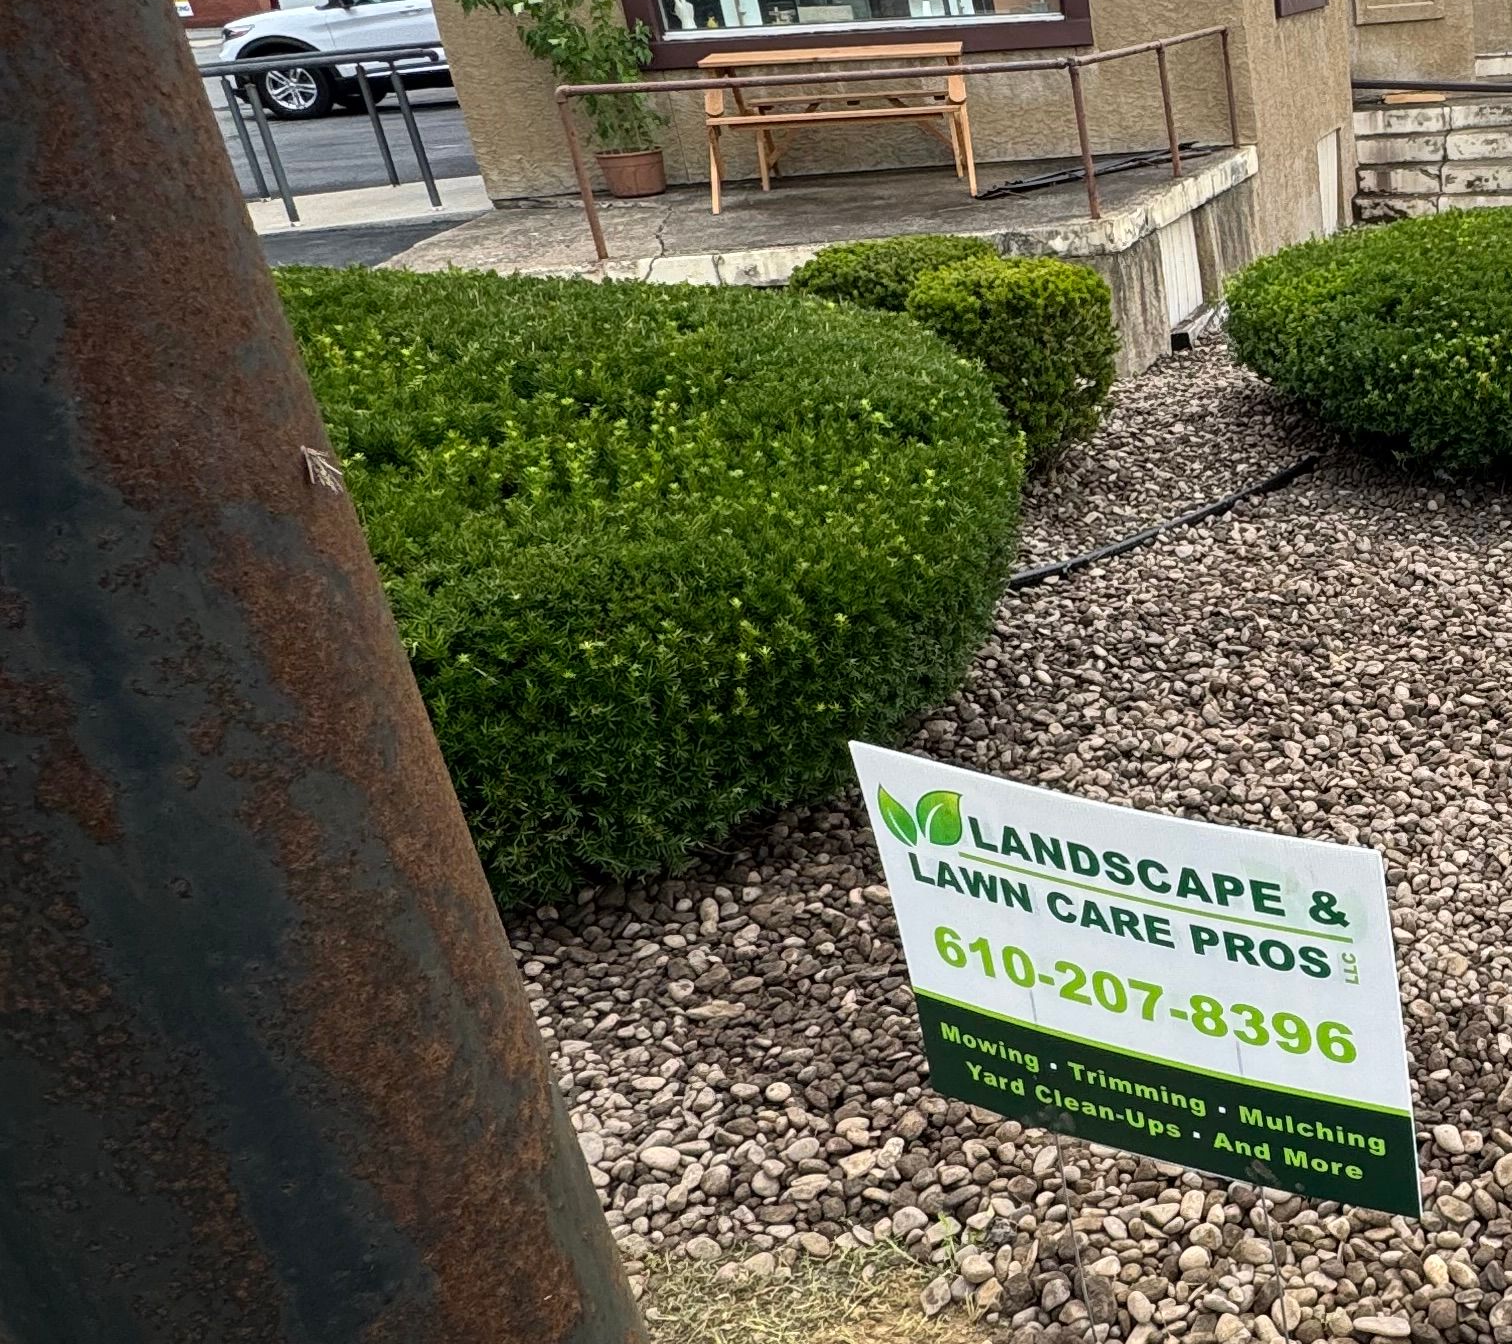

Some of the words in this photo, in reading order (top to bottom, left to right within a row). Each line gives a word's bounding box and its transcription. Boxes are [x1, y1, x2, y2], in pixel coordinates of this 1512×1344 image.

[908, 852, 1033, 913] LAWN
[1046, 891, 1176, 949] CARE
[1189, 924, 1331, 979] PROS
[968, 816, 1286, 917] LANDSCAPE
[1309, 890, 1350, 928] &
[934, 926, 1357, 1064] 610-207-8396
[1341, 952, 1360, 985] LLC
[940, 1022, 1040, 1074] Mowing
[1067, 1061, 1206, 1117] Trimming
[1238, 1105, 1386, 1156] Mulching
[964, 1061, 1025, 1096] Yard
[1035, 1084, 1181, 1139] Clean-Ups
[1213, 1132, 1271, 1162] And
[1283, 1147, 1363, 1180] More
